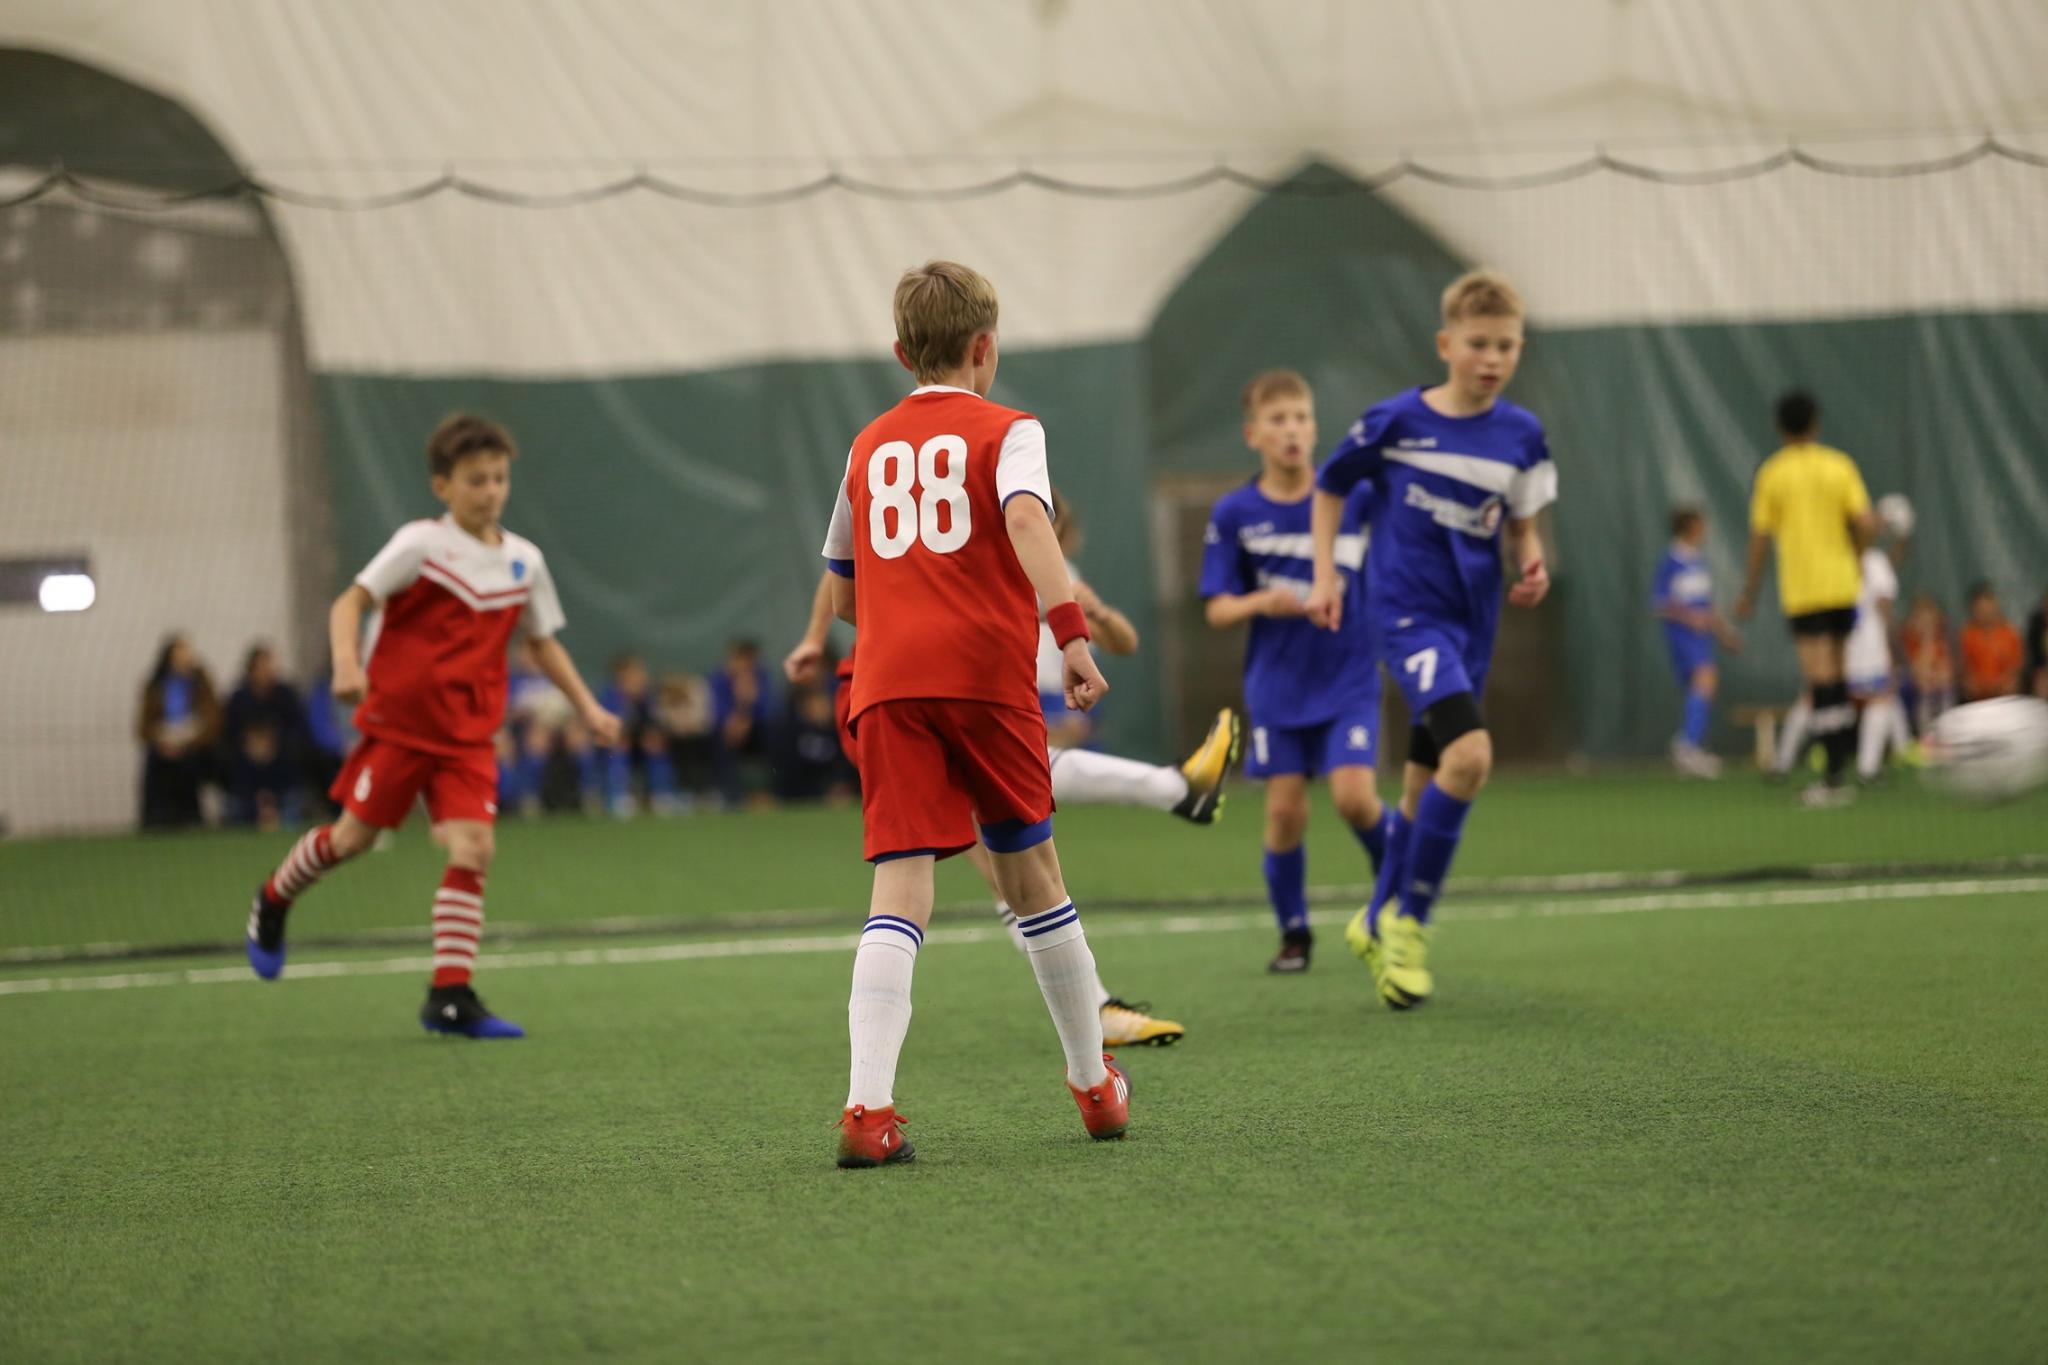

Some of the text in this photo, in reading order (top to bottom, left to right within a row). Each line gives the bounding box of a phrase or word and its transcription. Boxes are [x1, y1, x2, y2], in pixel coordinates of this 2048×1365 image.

[868, 434, 972, 560] 88
[1405, 647, 1438, 692] 7
[353, 766, 372, 802] 6
